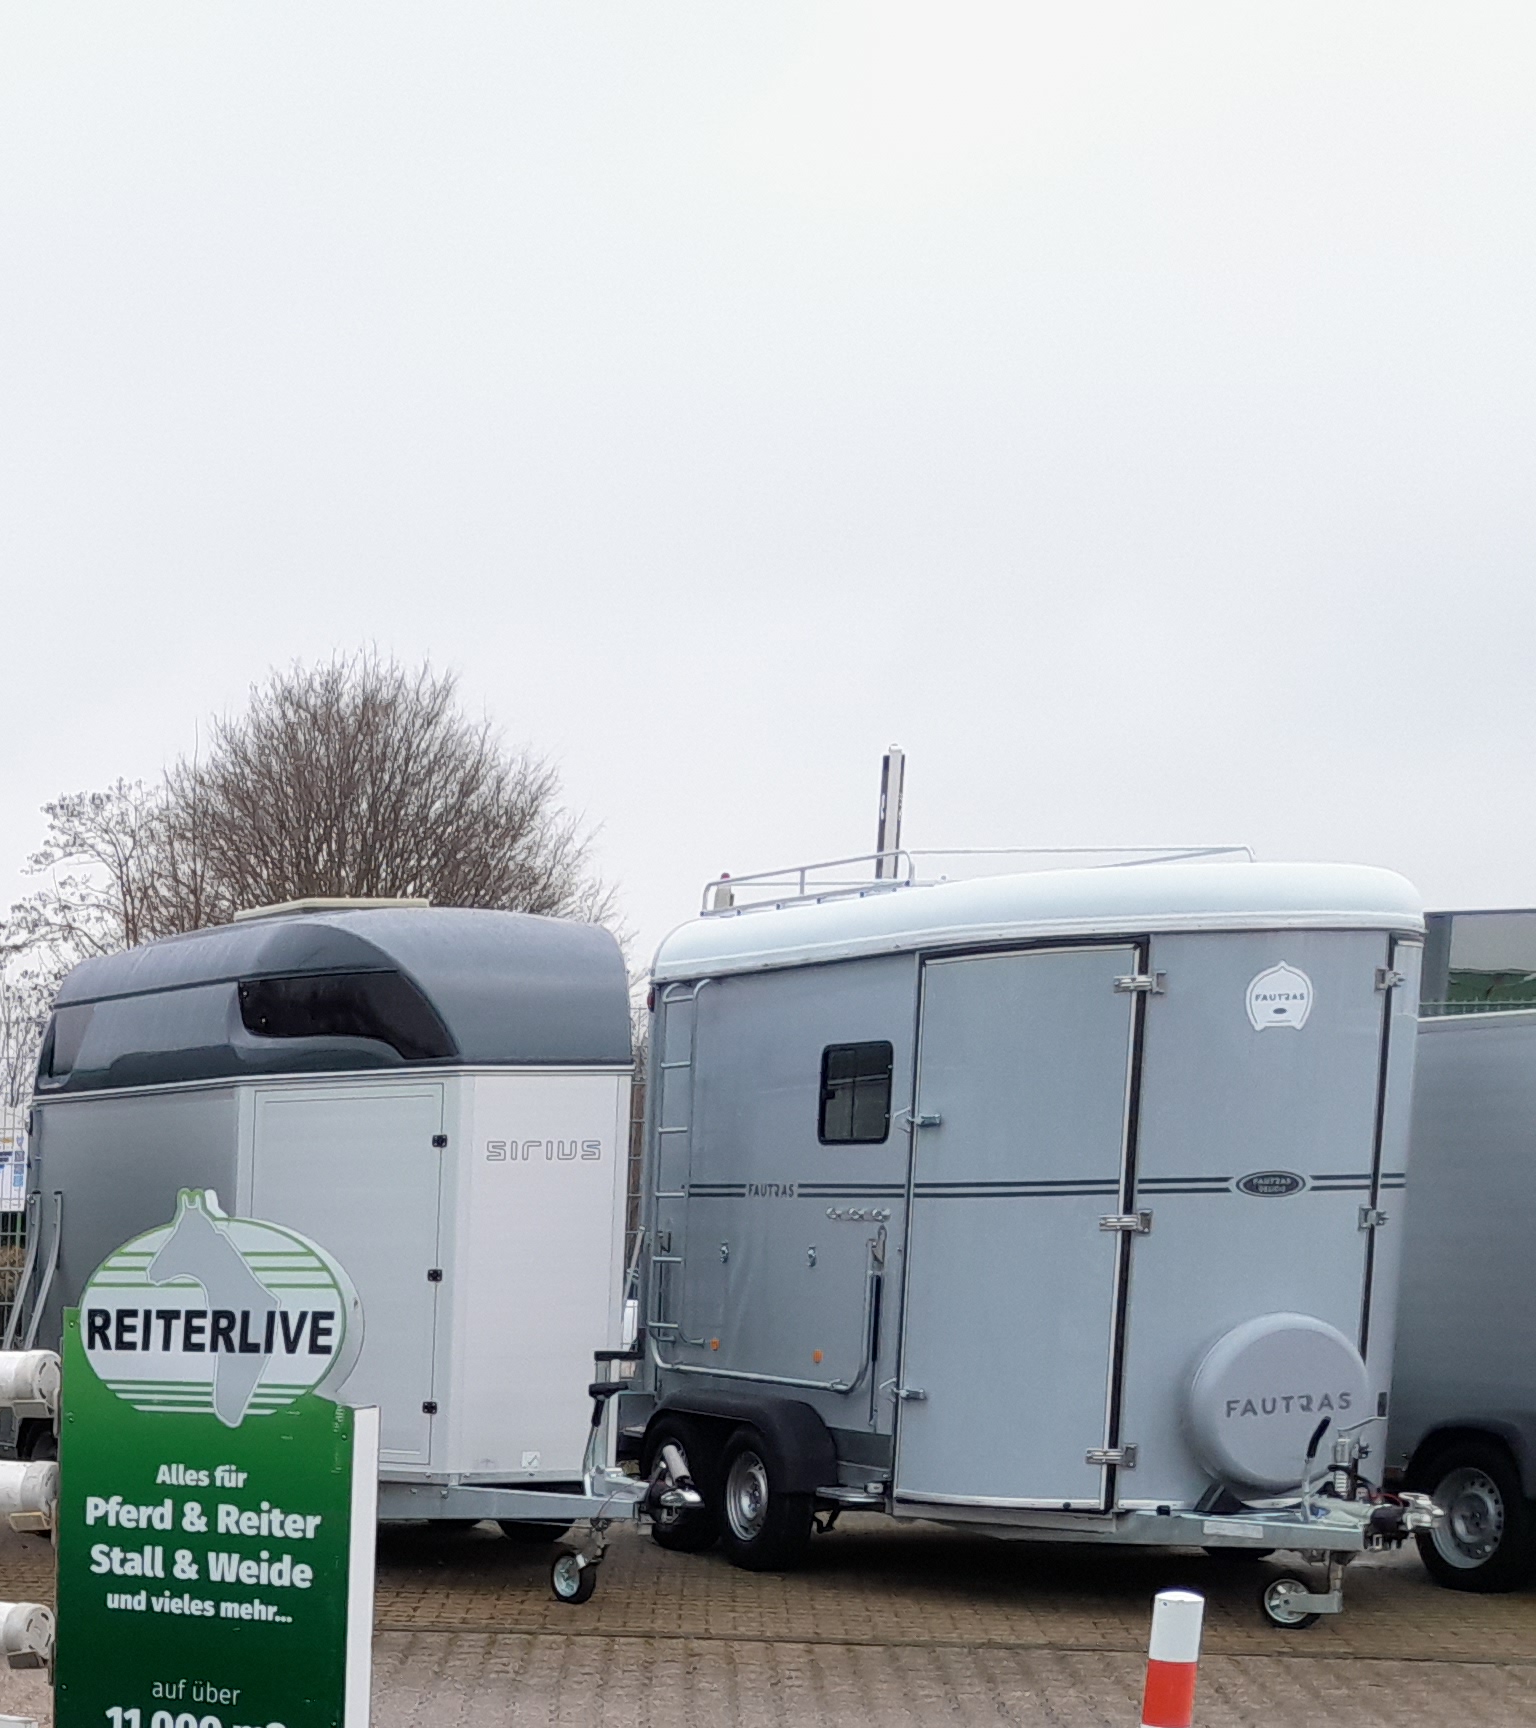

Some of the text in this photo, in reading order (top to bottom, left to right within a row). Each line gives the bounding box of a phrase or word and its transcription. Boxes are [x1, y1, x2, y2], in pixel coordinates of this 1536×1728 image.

[86, 1307, 335, 1356] REITERLIVE
[1225, 1391, 1352, 1419] FAUTRAS
[156, 1463, 248, 1489] Alles für
[85, 1495, 322, 1539] Pferd & Reiter
[90, 1543, 313, 1589] Stall & Weide
[106, 1590, 293, 1623] und vieles mehr...
[152, 1679, 241, 1706] auf über
